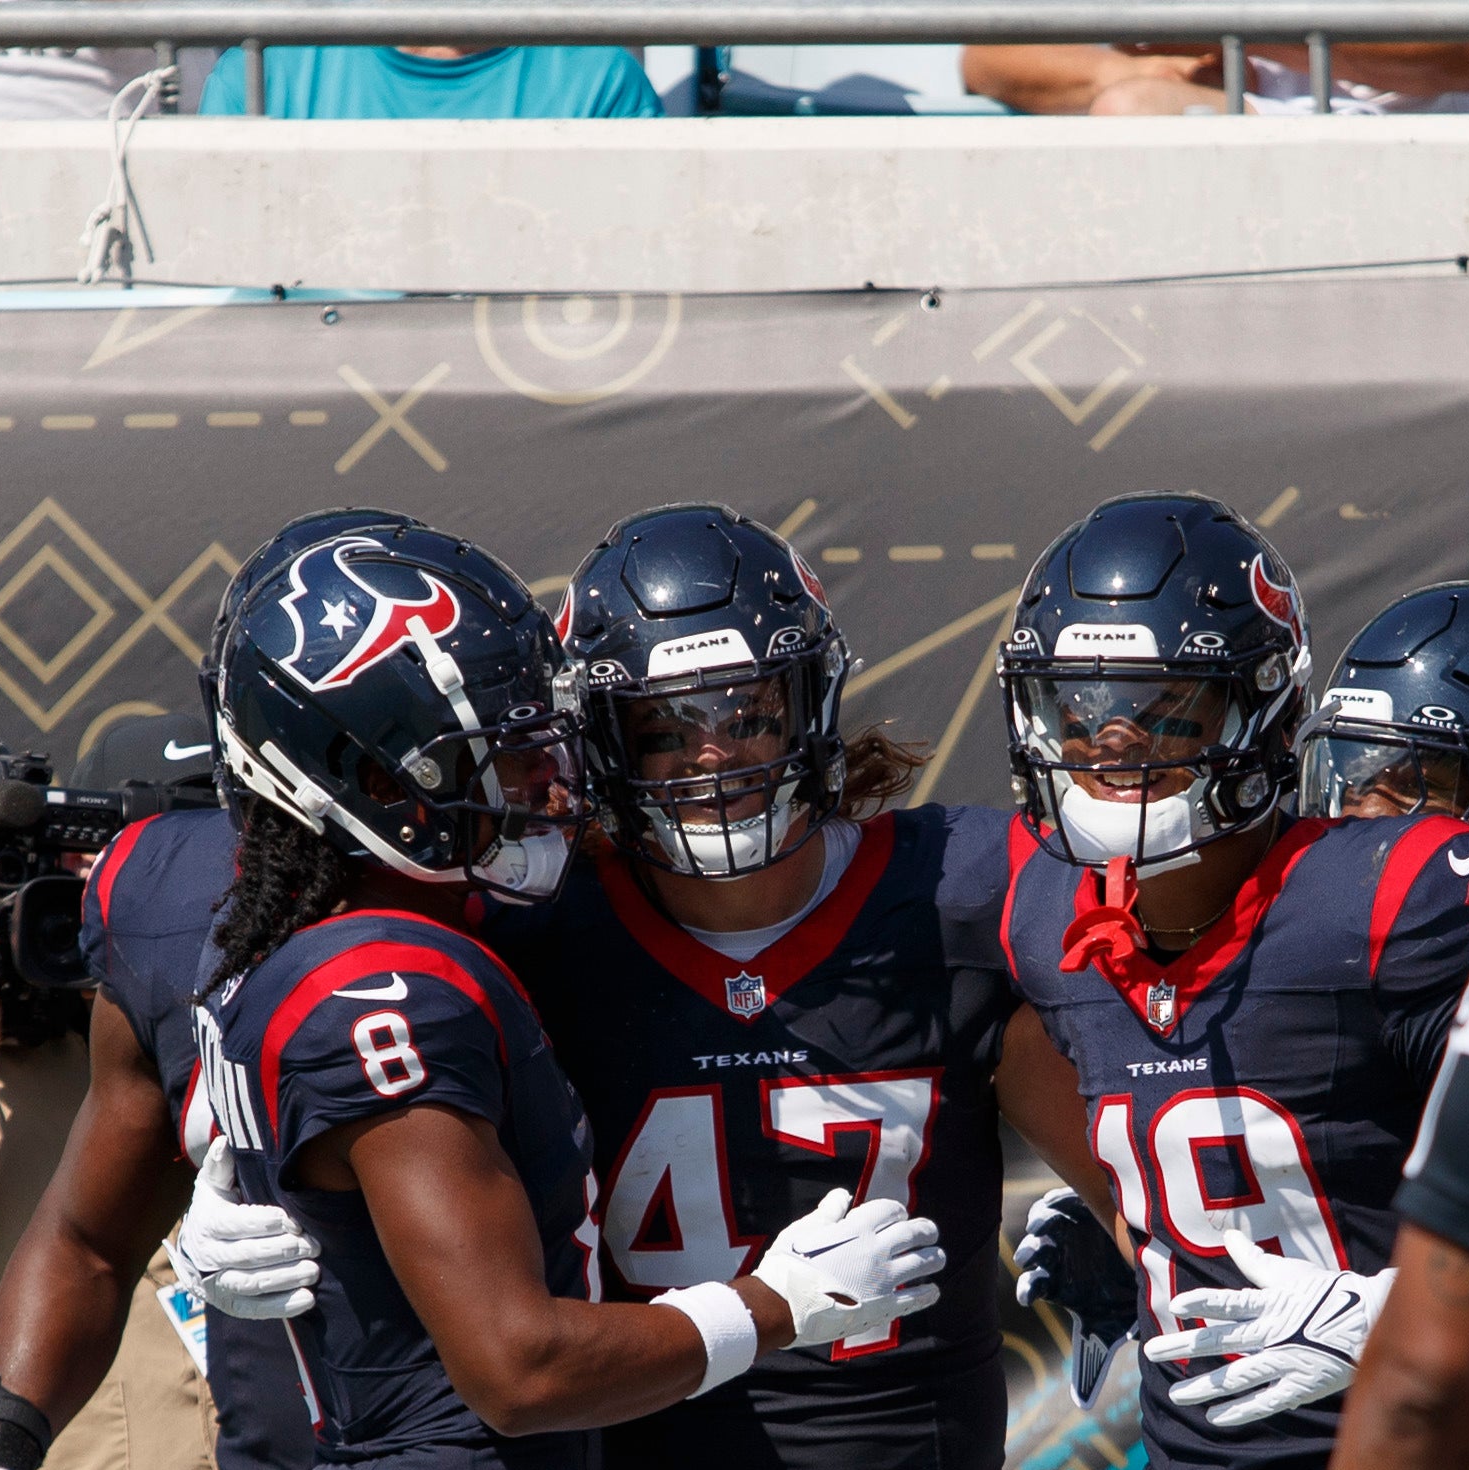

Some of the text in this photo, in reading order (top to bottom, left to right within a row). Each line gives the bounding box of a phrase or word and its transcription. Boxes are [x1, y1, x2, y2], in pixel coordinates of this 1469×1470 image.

[1070, 632, 1137, 641] TEXANS
[661, 636, 730, 656] TEXANS
[772, 641, 808, 655] OAKLEY
[1184, 645, 1230, 657] OAKLEY
[588, 674, 623, 685] OAKLEY
[1411, 715, 1461, 730] OAKLEY
[79, 797, 108, 805] SONY
[733, 992, 760, 1009] NFL
[349, 1008, 429, 1099] 8
[692, 1049, 809, 1070] TEXANS
[1126, 1057, 1208, 1077] TEXANS
[601, 1067, 946, 1362] 47
[1092, 1086, 1351, 1375] 19
